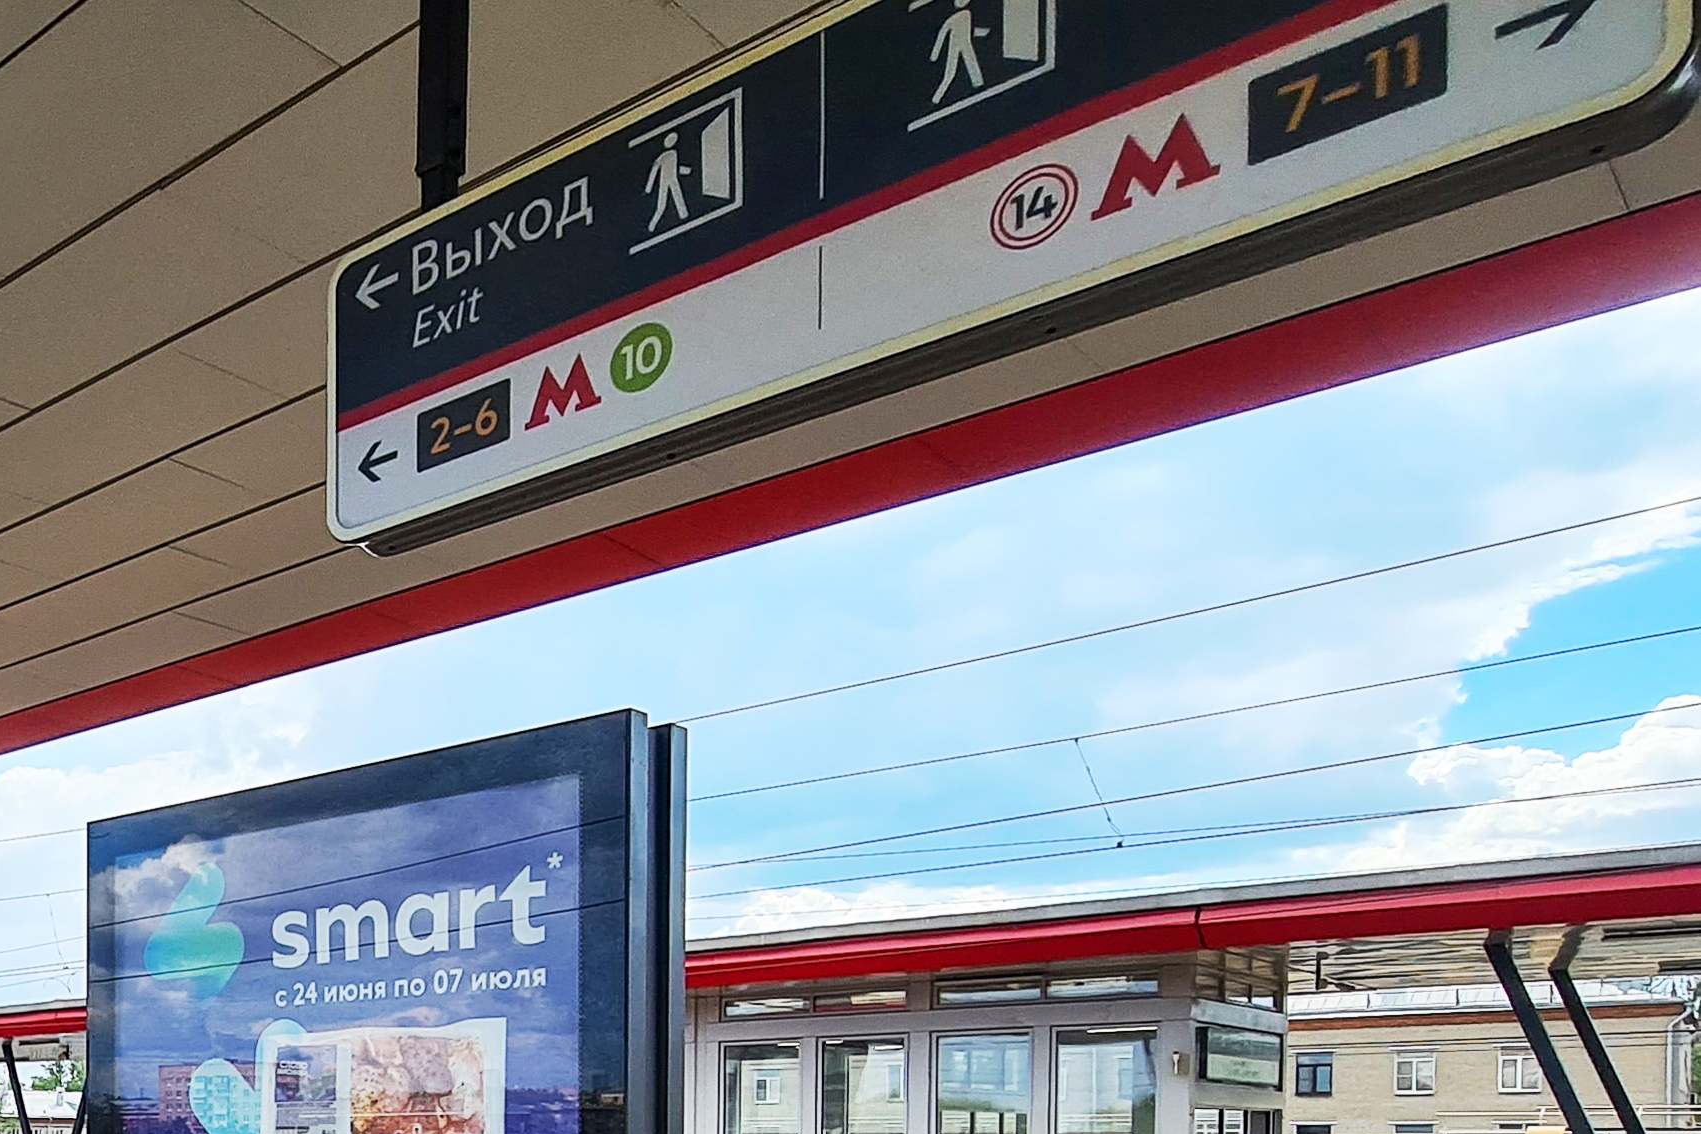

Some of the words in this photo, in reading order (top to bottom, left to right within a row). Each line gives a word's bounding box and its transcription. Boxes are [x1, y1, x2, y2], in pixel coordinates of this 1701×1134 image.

[1010, 185, 1057, 231] 14
[1276, 34, 1422, 134] 7-11
[411, 176, 594, 295] Выход
[412, 285, 484, 348] Exit
[430, 398, 499, 455] 2-6
[619, 336, 662, 381] 10
[274, 990, 287, 1007] с
[292, 981, 318, 1006] 24
[324, 981, 387, 1003] июня
[393, 977, 426, 998] по
[433, 968, 464, 994] 07
[470, 967, 547, 992] июля
